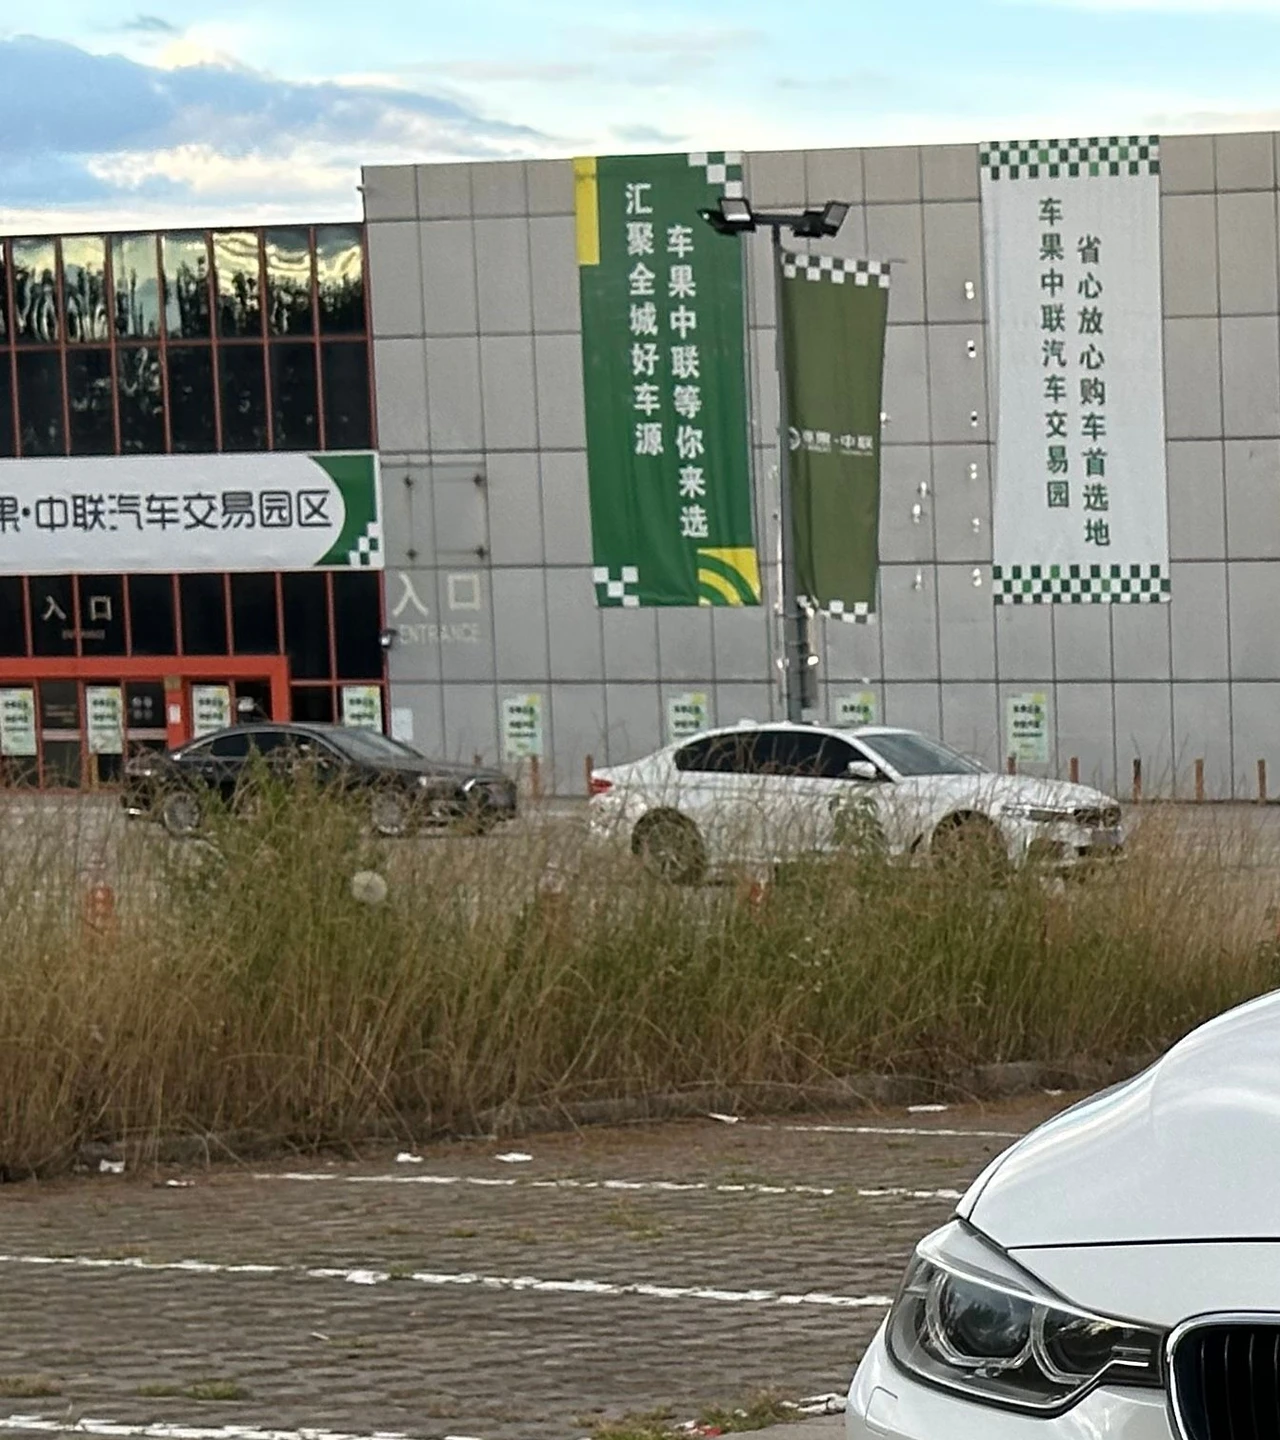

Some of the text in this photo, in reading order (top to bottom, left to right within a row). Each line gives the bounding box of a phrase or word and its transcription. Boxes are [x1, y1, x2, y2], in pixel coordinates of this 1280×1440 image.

[625, 182, 664, 456] 汇聚全城好车源
[666, 224, 709, 537] 车果中联等你来选
[1039, 197, 1069, 508] 车果中联汽车交易园
[1077, 233, 1110, 547] 省心放心购车首选地
[42, 595, 112, 621] 入口
[392, 571, 480, 616] 入口
